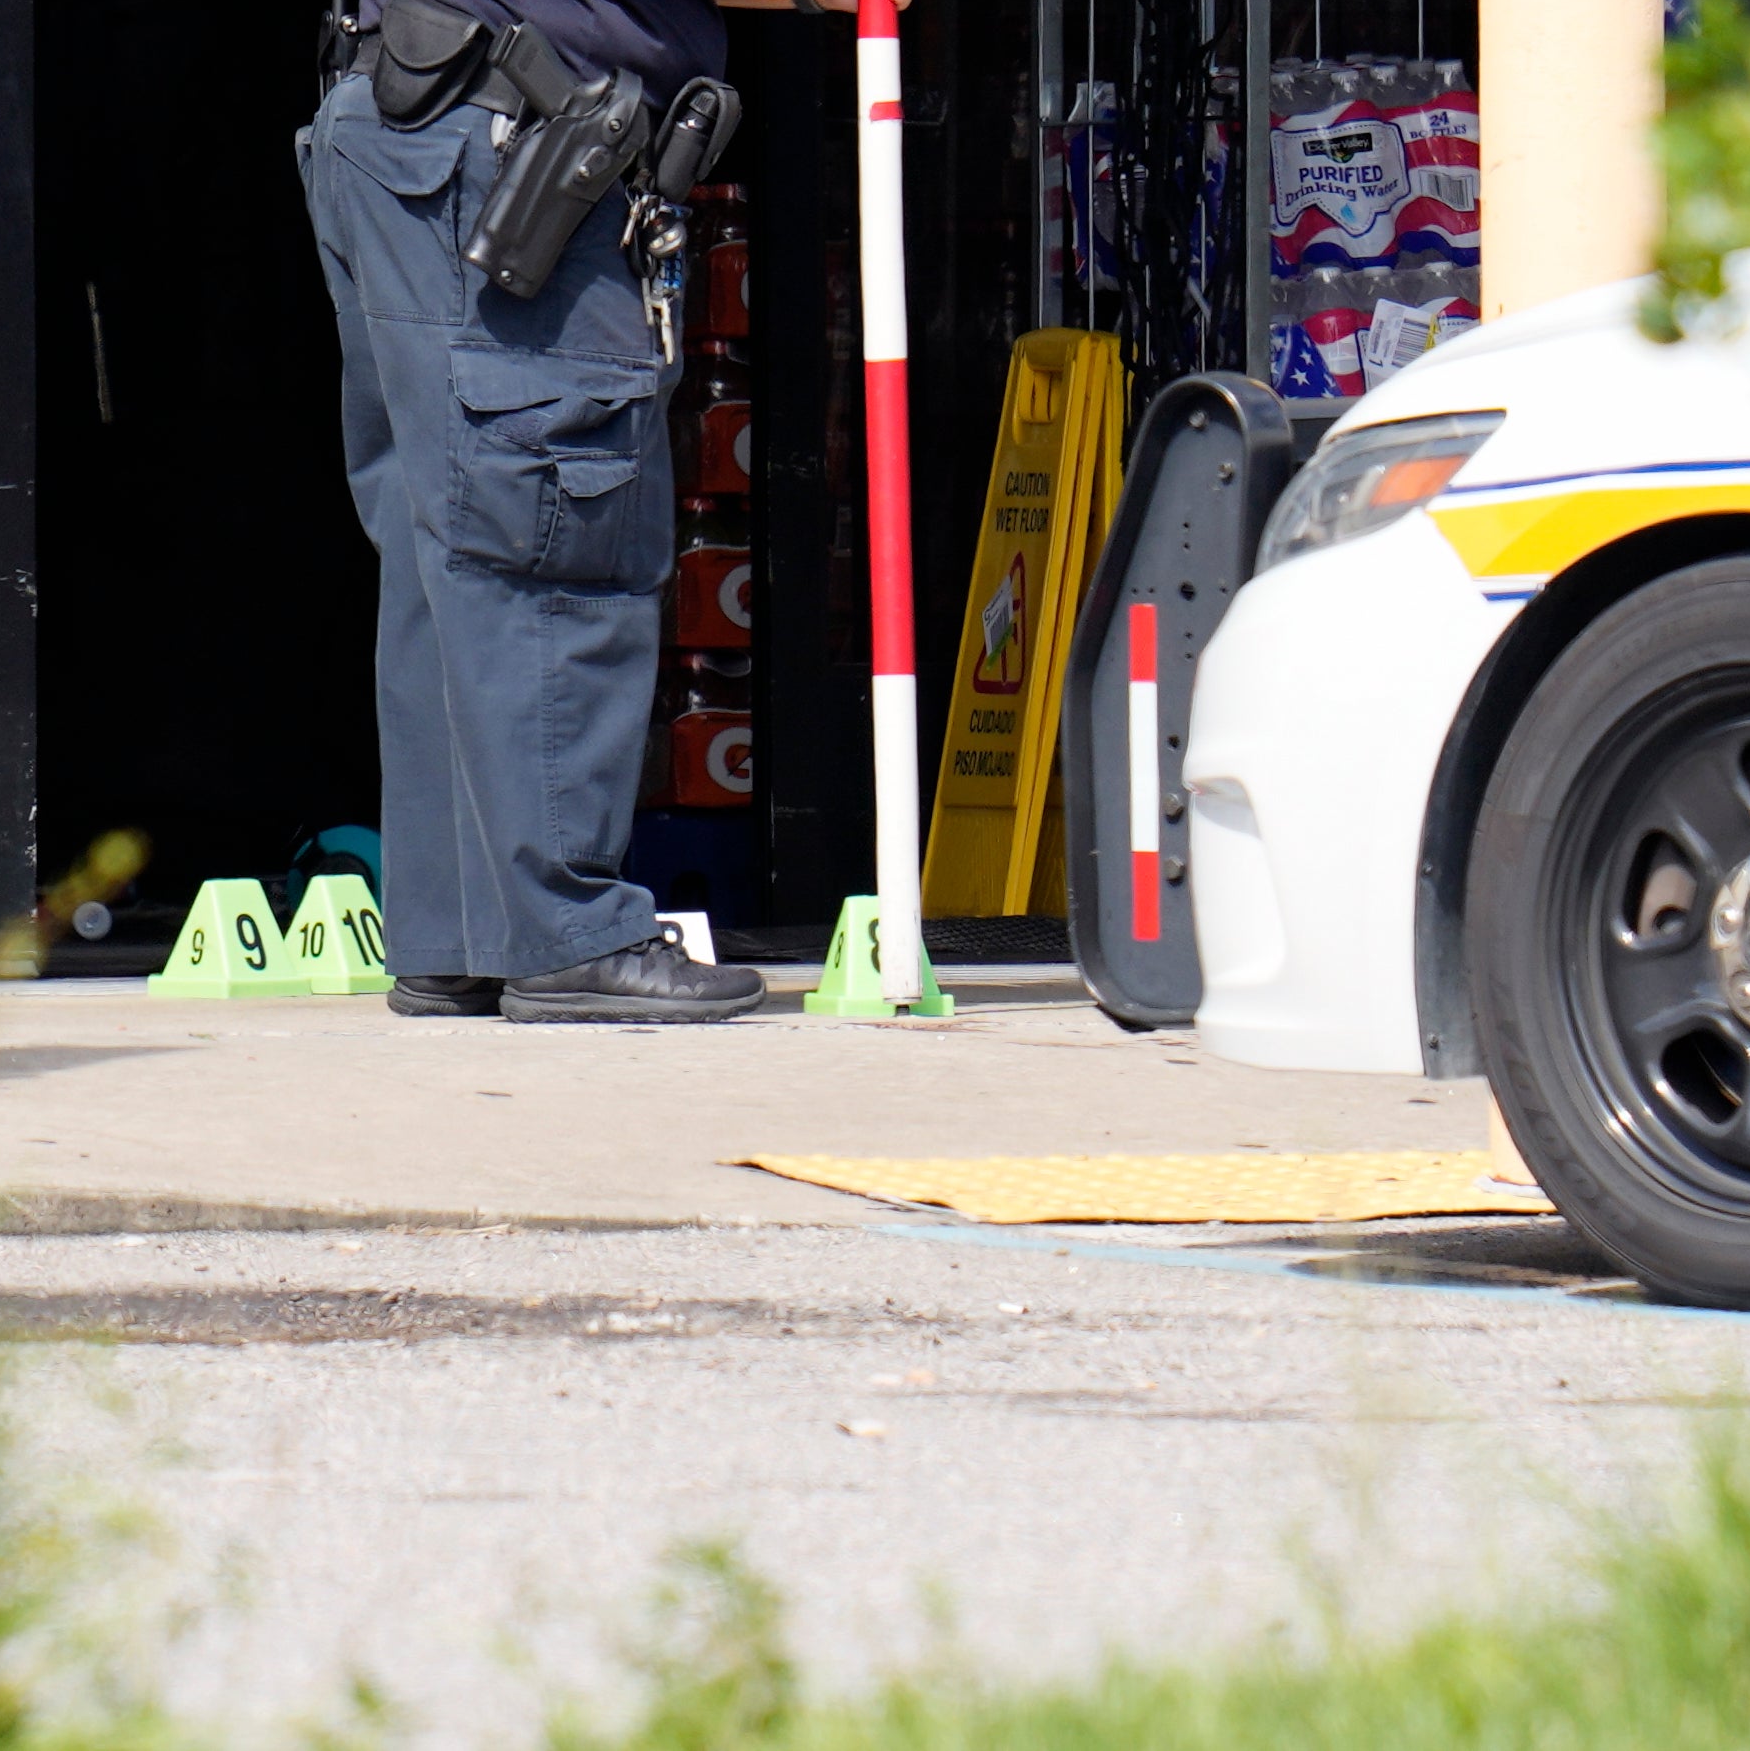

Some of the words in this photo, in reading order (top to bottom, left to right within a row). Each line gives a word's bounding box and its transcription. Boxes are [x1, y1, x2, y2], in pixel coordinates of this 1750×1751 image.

[1428, 111, 1449, 127] 24
[1300, 165, 1383, 183] PURIFIED
[1285, 182, 1356, 206] Drinking
[1362, 178, 1399, 198] Water
[1005, 471, 1049, 497] CAUTION
[996, 507, 1018, 533] WET
[1020, 507, 1049, 533] FLOOR
[969, 710, 1015, 734] CUIDADO
[954, 750, 976, 776] PISO
[977, 752, 1015, 777] MOJADO
[191, 928, 205, 966] 9
[236, 913, 267, 971] 9
[299, 921, 325, 959] 10
[342, 908, 385, 967] 10
